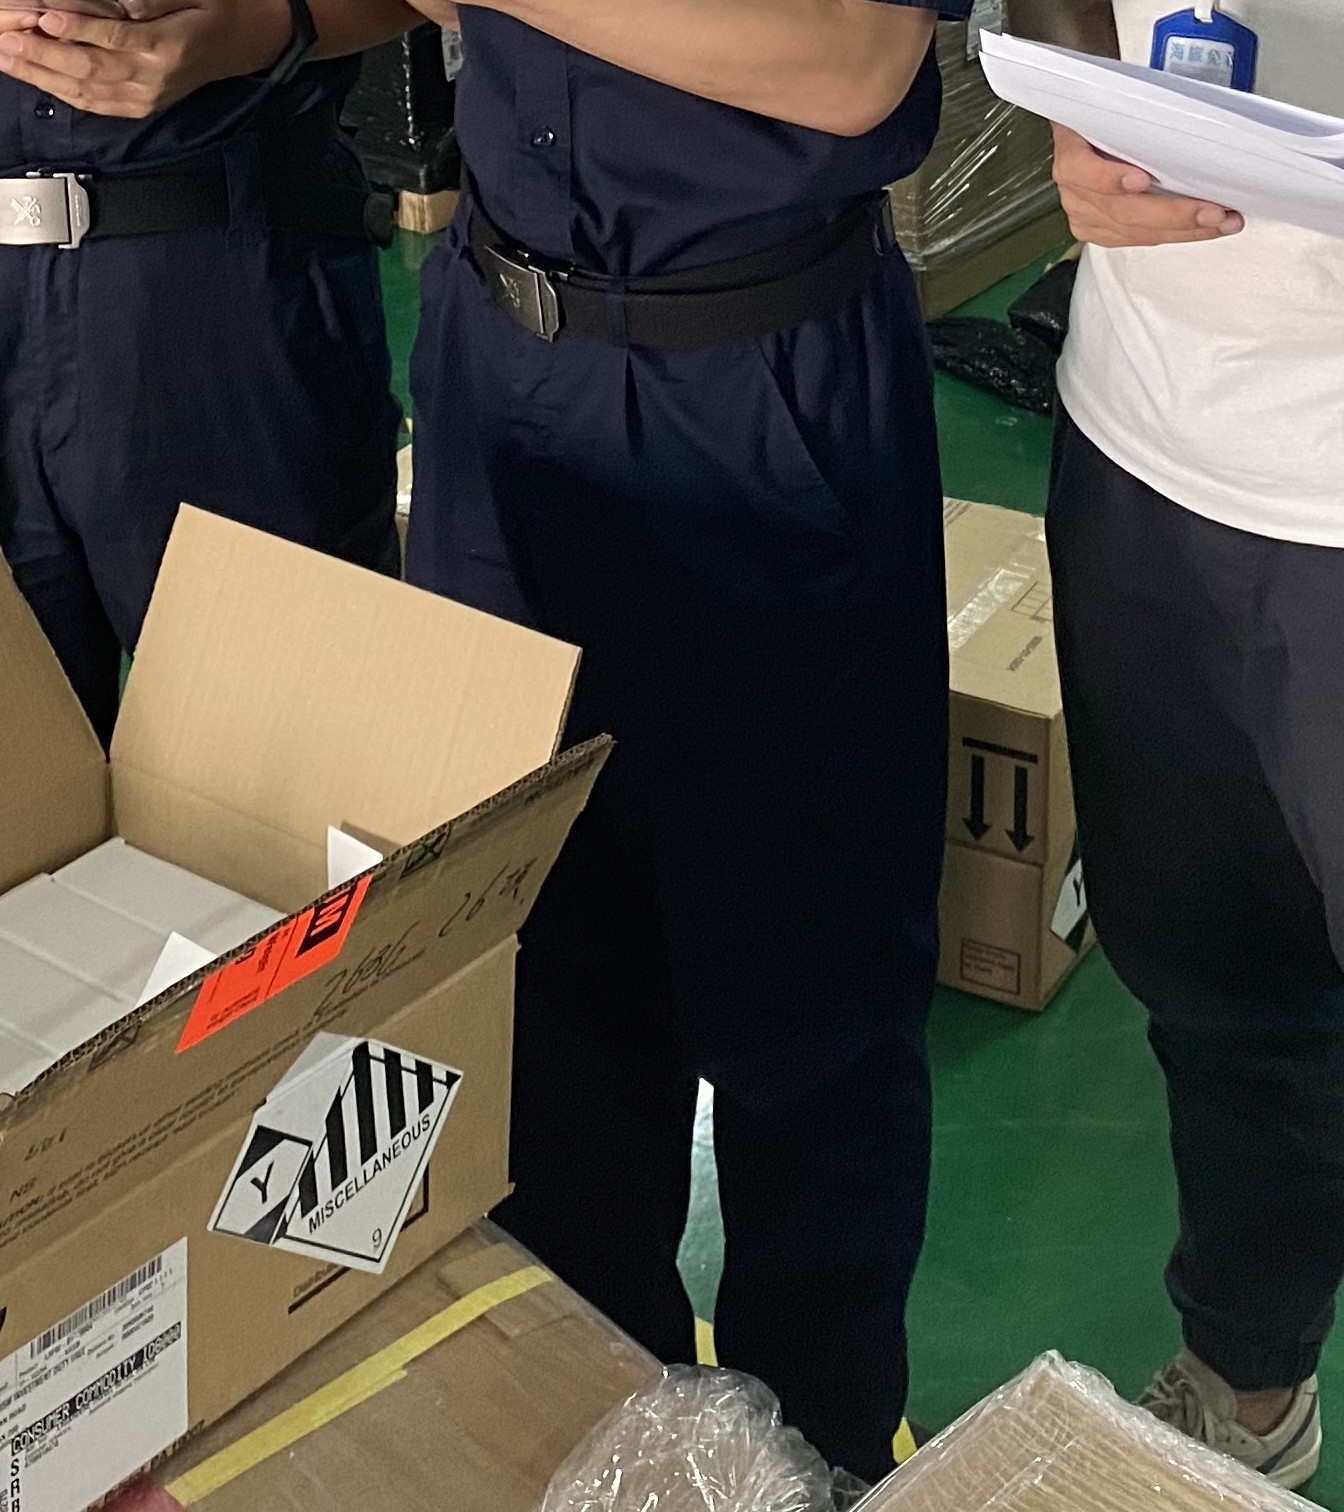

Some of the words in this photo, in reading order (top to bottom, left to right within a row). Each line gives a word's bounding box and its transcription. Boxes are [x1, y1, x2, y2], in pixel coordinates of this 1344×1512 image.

[250, 1161, 275, 1205] Y
[308, 1113, 431, 1236] MISCELLANEOUS
[371, 1228, 383, 1249] 9
[12, 1401, 71, 1455] CONSUMER
[73, 1356, 138, 1410] COMMODITY
